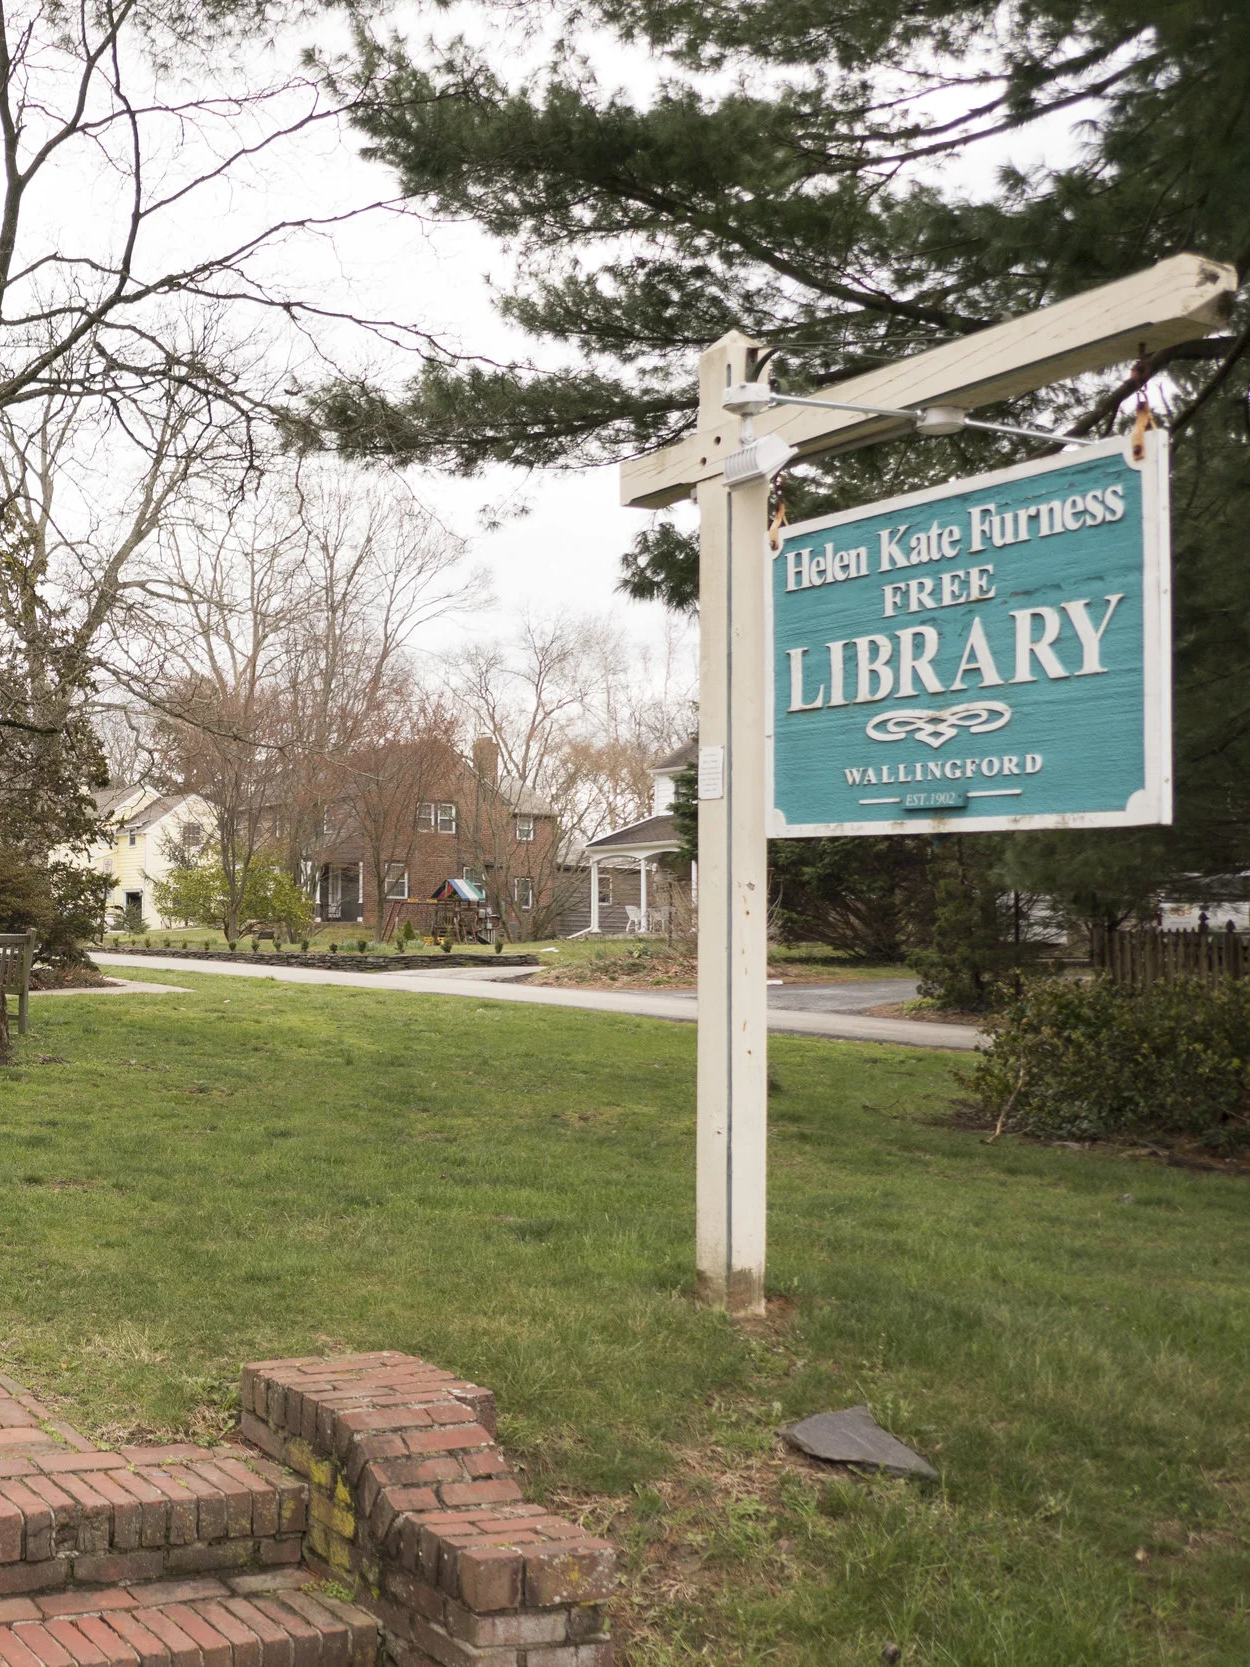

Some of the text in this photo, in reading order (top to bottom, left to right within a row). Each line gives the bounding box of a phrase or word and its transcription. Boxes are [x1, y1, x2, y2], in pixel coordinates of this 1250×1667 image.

[784, 484, 1126, 593] Helen Kate Furness
[882, 564, 997, 618] FREE
[785, 593, 1125, 713] LIBRARY
[843, 753, 1043, 786] WALLINGFORD
